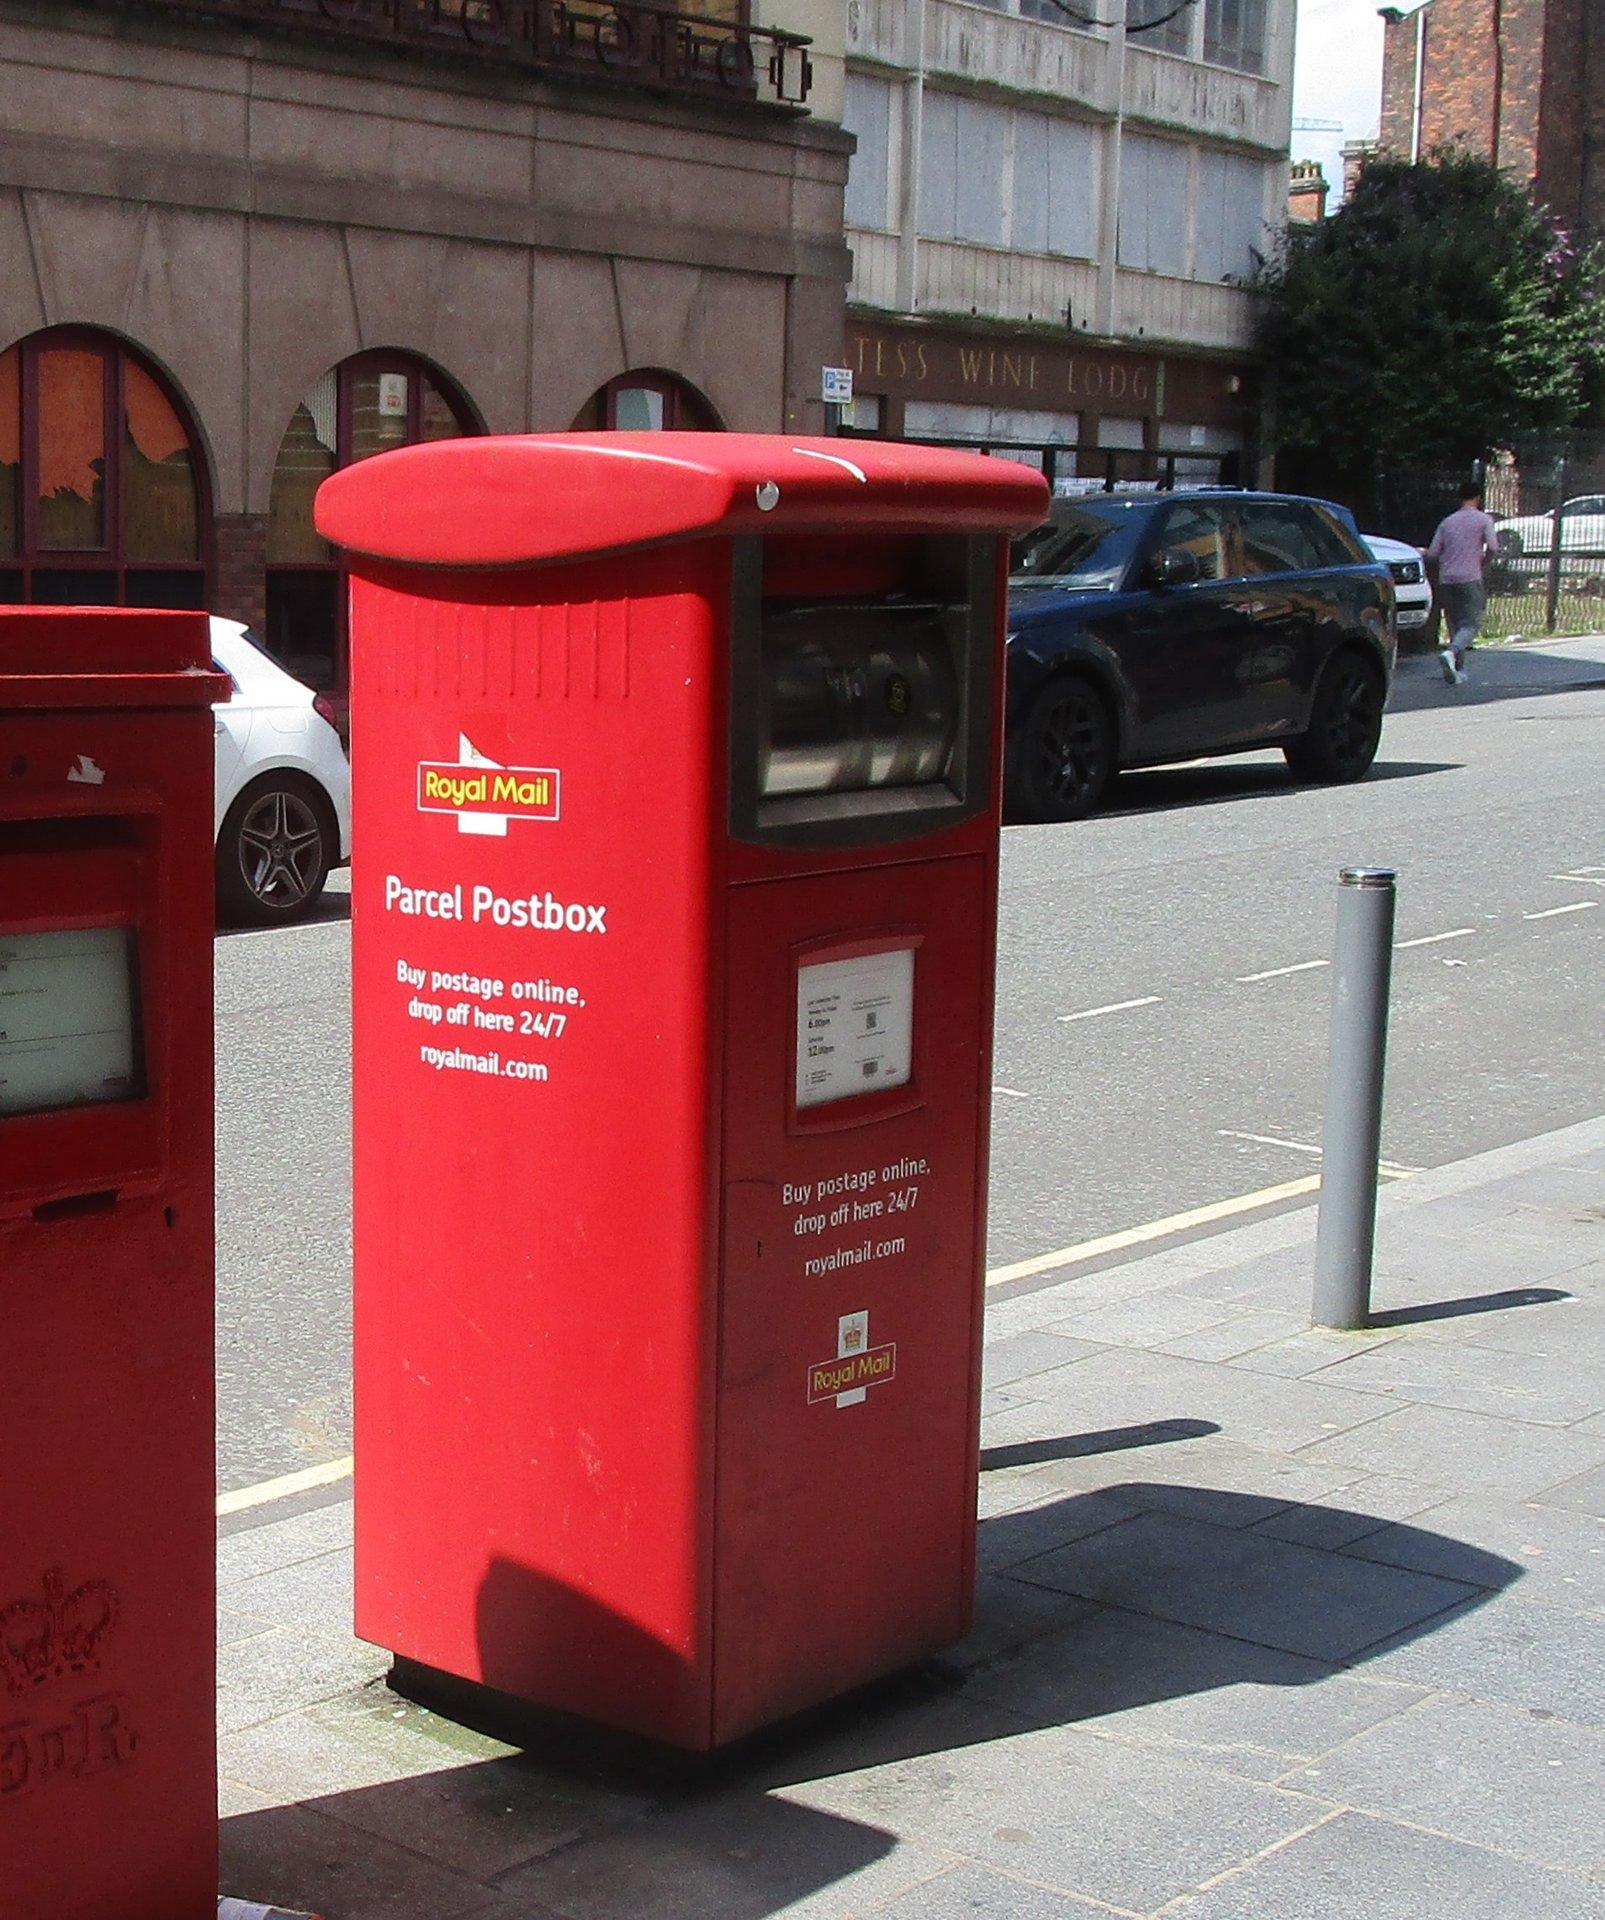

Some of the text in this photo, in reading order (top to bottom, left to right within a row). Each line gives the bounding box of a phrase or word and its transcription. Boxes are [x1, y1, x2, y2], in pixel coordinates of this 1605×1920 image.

[425, 770, 549, 807] Royal Mail
[385, 874, 607, 934] Parcel Postbox
[396, 959, 586, 1008] Buy postage online,
[408, 995, 567, 1039] drop off here 24/7
[420, 1045, 548, 1082] royalmail.com
[782, 1157, 931, 1206] Buy postage online,
[794, 1186, 919, 1236] drop off here 24/7
[805, 1237, 905, 1277] royalmail.com
[814, 1351, 890, 1392] Royal Mail
